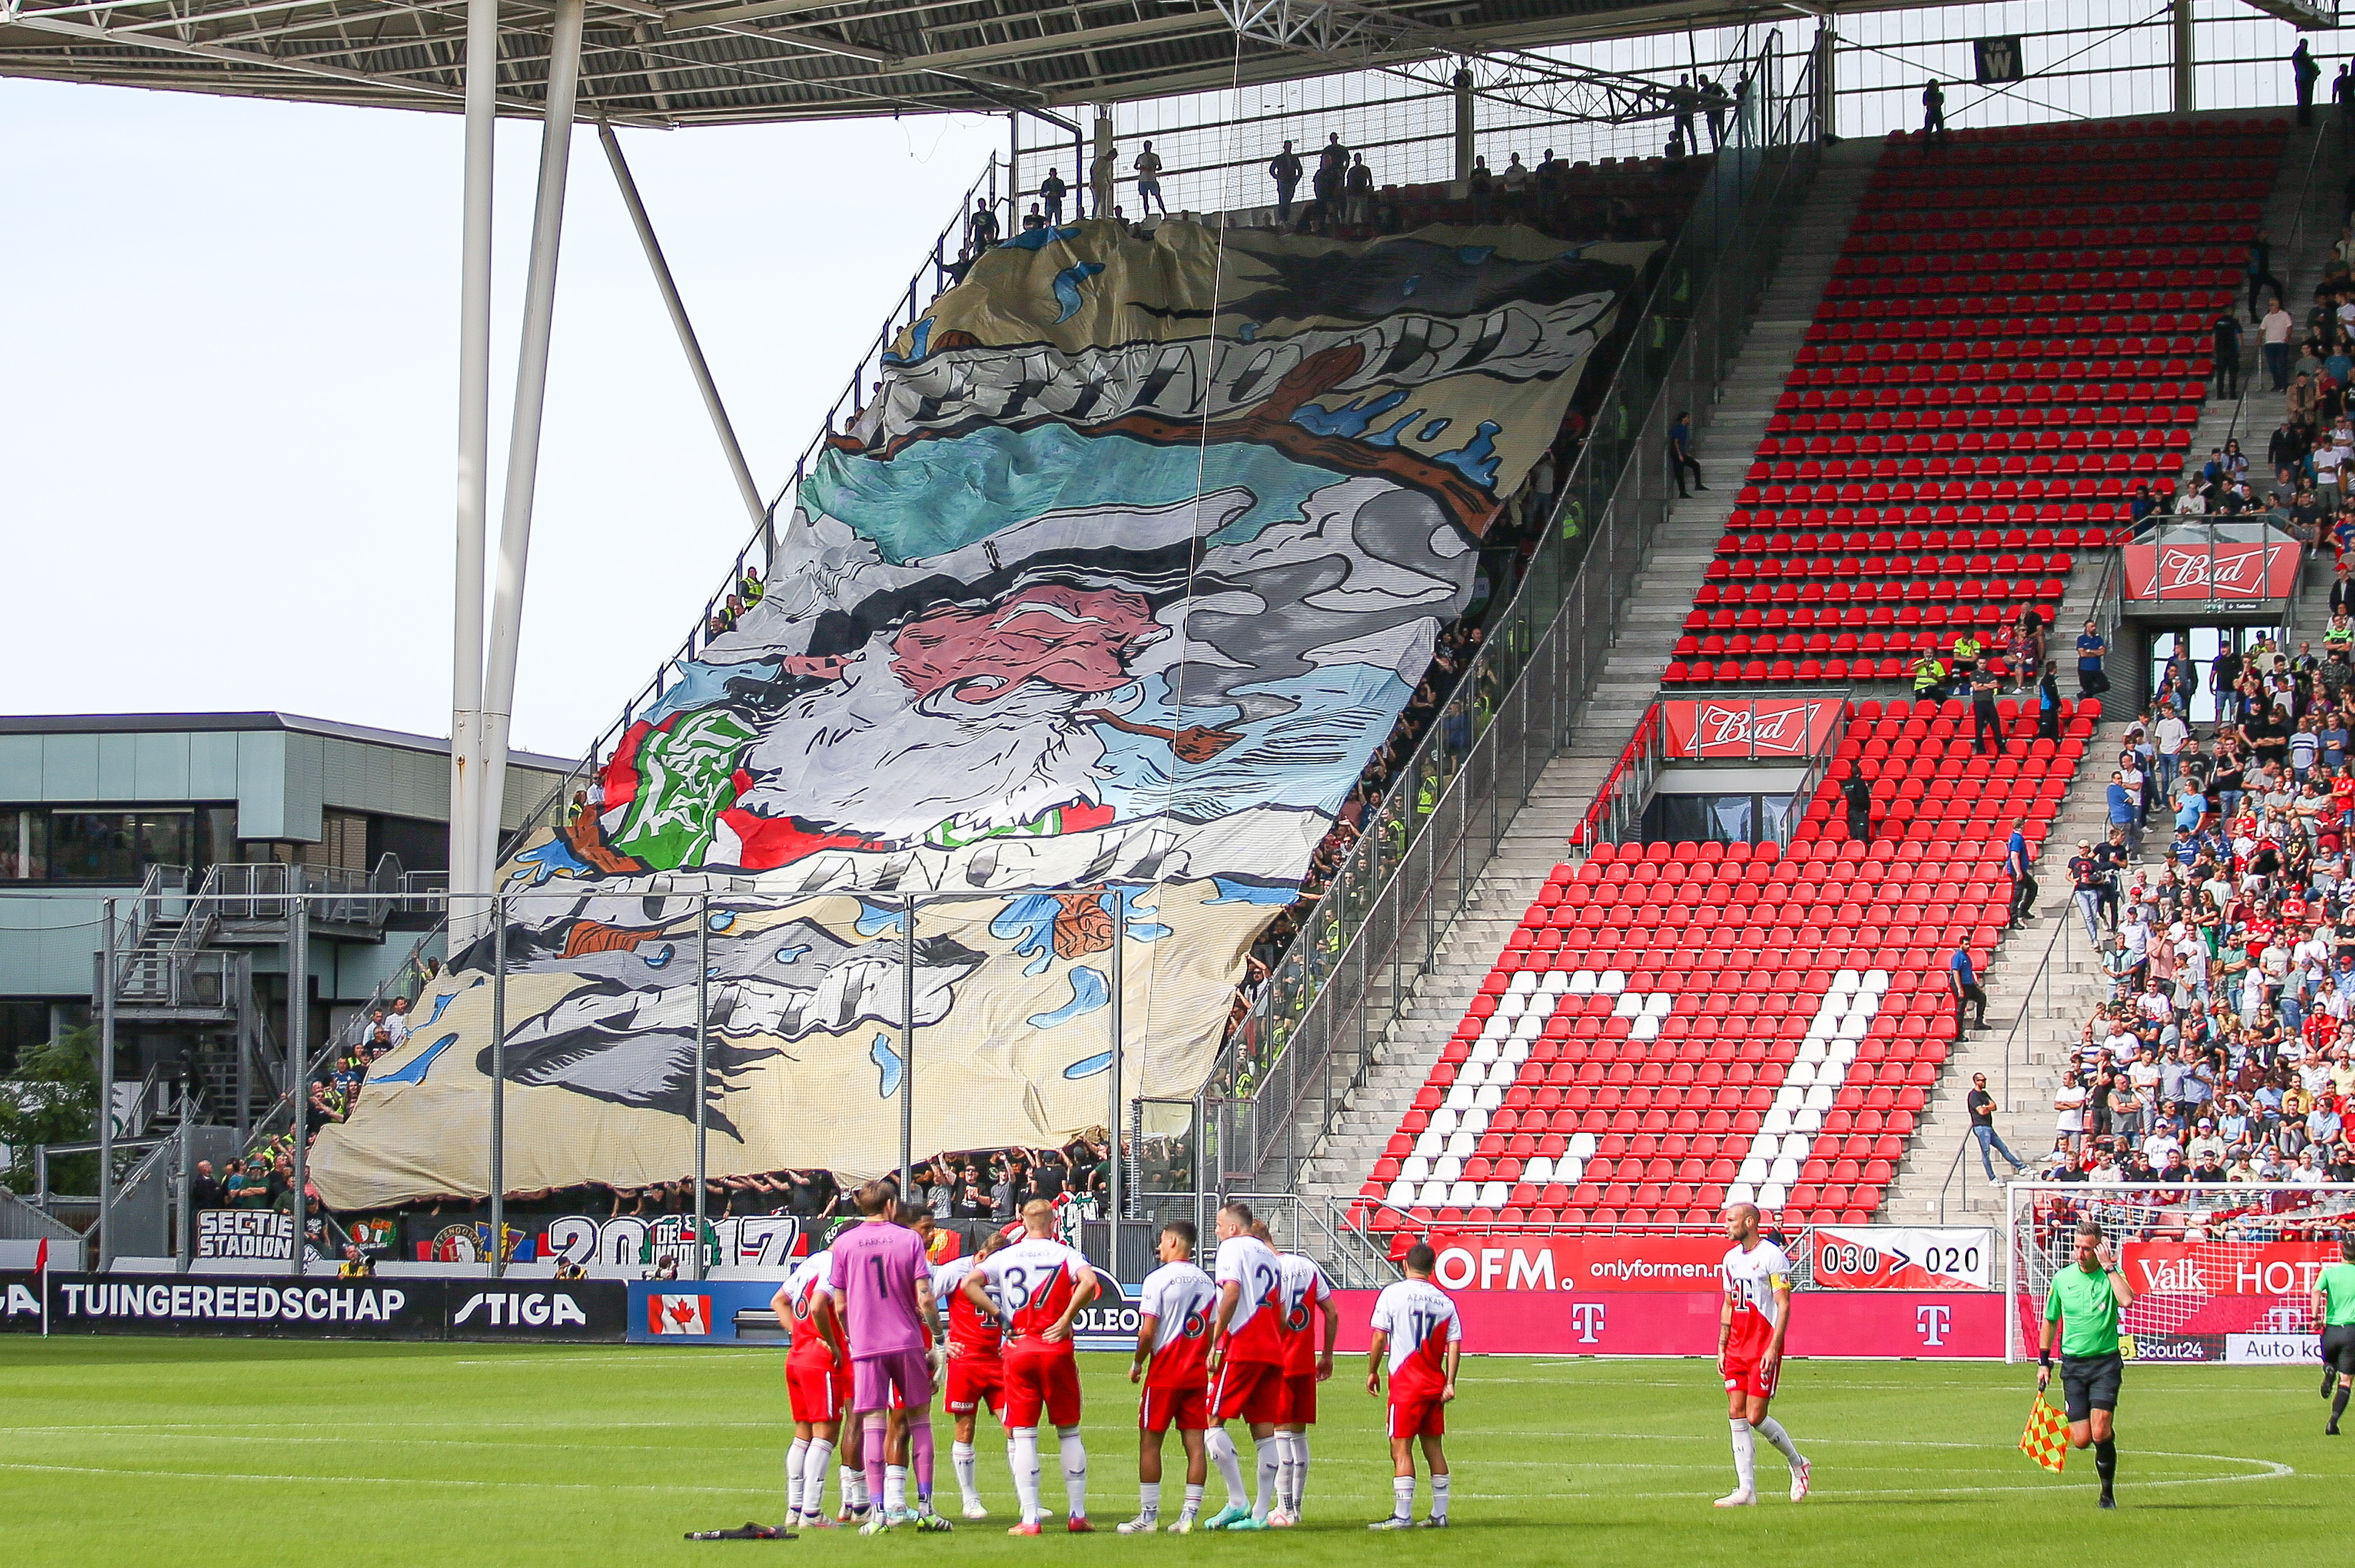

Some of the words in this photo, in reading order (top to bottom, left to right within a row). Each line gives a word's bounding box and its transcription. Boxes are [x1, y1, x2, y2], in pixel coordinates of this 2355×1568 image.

[1985, 51, 2012, 79] W
[2168, 554, 2246, 585] Bud
[1709, 710, 1786, 742] Bud
[200, 1212, 293, 1238] SECTIE
[433, 1226, 479, 1254] FEYENOORD
[656, 1224, 678, 1244] DE
[200, 1235, 292, 1260] STADION
[859, 1235, 894, 1247] BARKAS
[1434, 1247, 1575, 1291] OFM.
[1821, 1244, 1880, 1275] 030
[1925, 1246, 1979, 1273] 020
[869, 1255, 888, 1300] 1
[1004, 1265, 1066, 1310] 37
[2138, 1258, 2207, 1290] Valk
[2235, 1261, 2341, 1295] HOT
[62, 1284, 405, 1320] TUINGEREEDSCHAP
[454, 1292, 587, 1326] STIGA
[1183, 1292, 1206, 1339] 6
[1287, 1289, 1310, 1331] 5
[1407, 1294, 1444, 1308] AZARKAN
[2246, 1340, 2294, 1358] Auto
